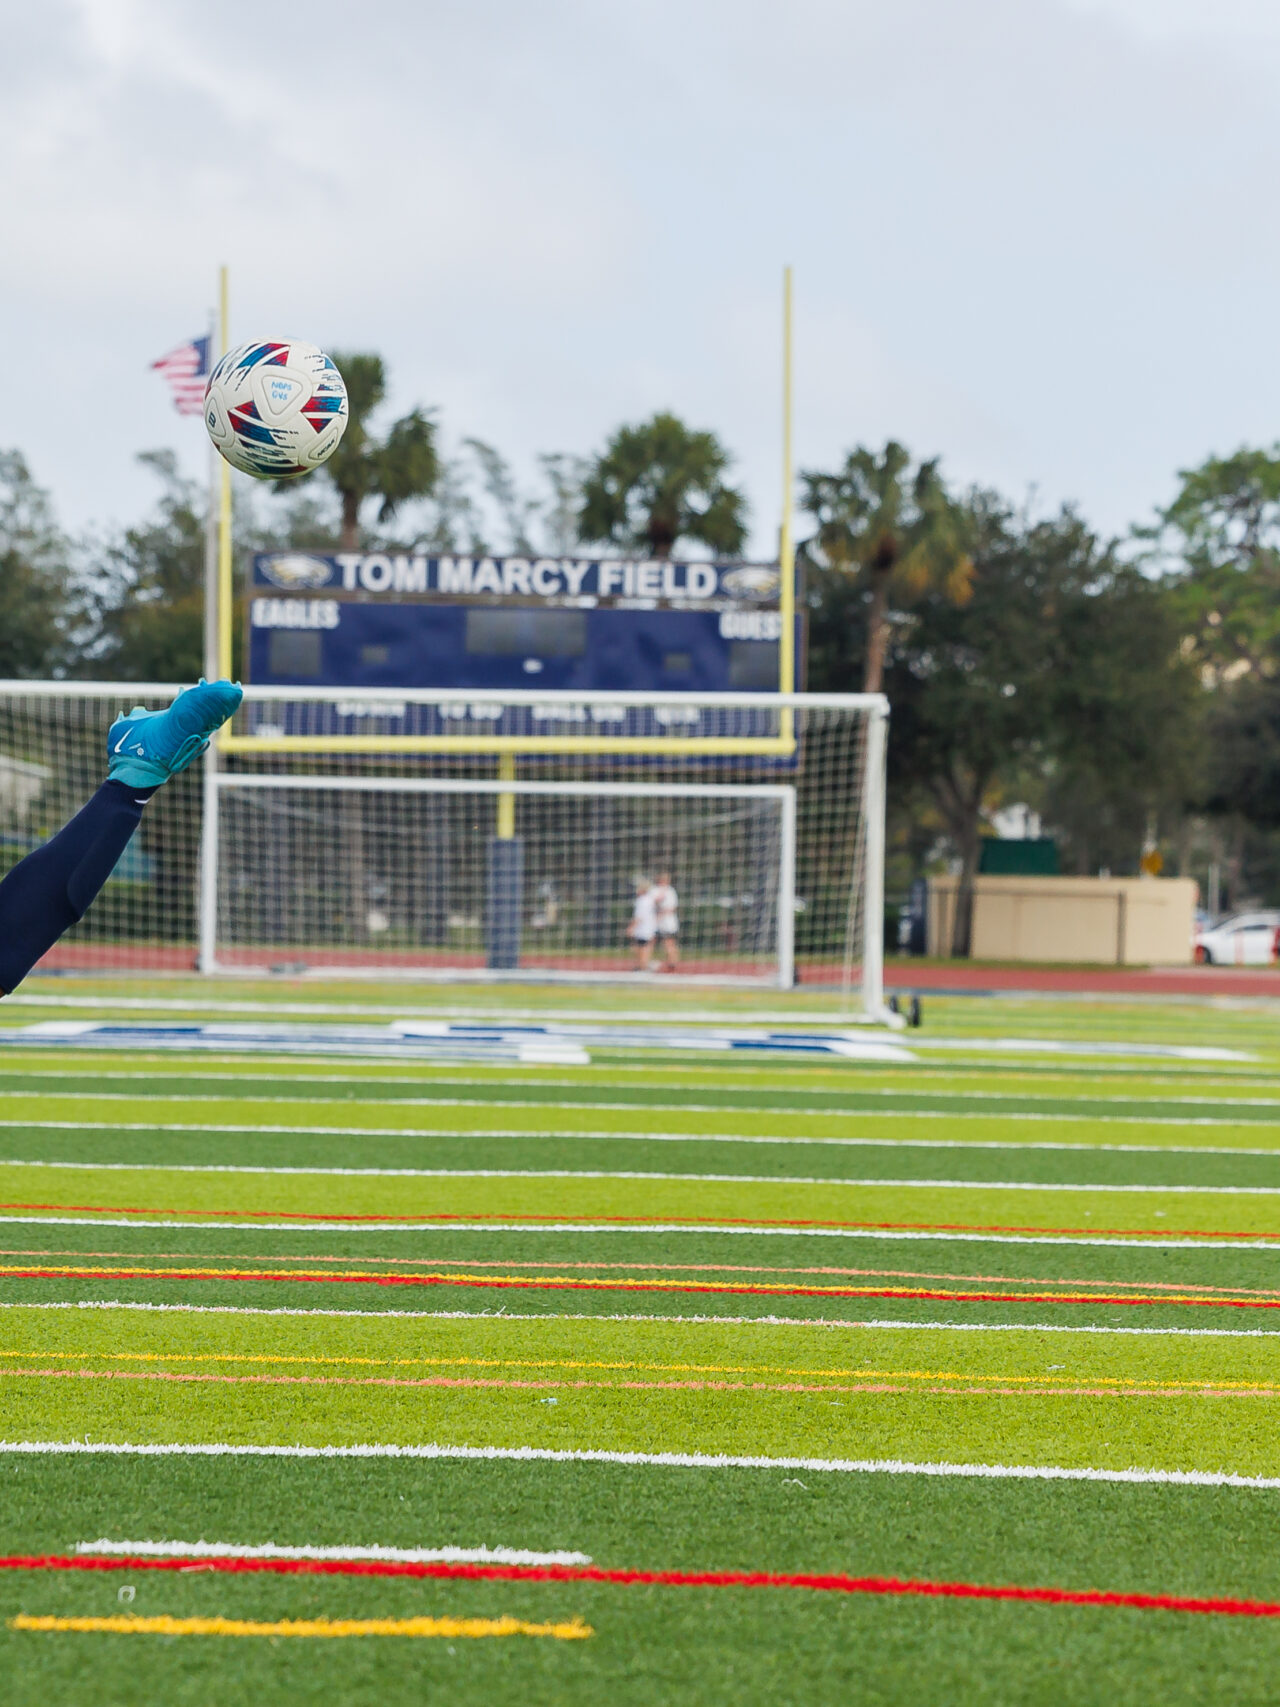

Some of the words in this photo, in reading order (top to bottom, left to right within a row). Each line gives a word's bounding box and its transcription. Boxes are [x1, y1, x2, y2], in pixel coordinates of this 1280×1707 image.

[335, 554, 426, 592] TOM
[437, 555, 590, 596] MARCY
[597, 559, 718, 598] FIELD
